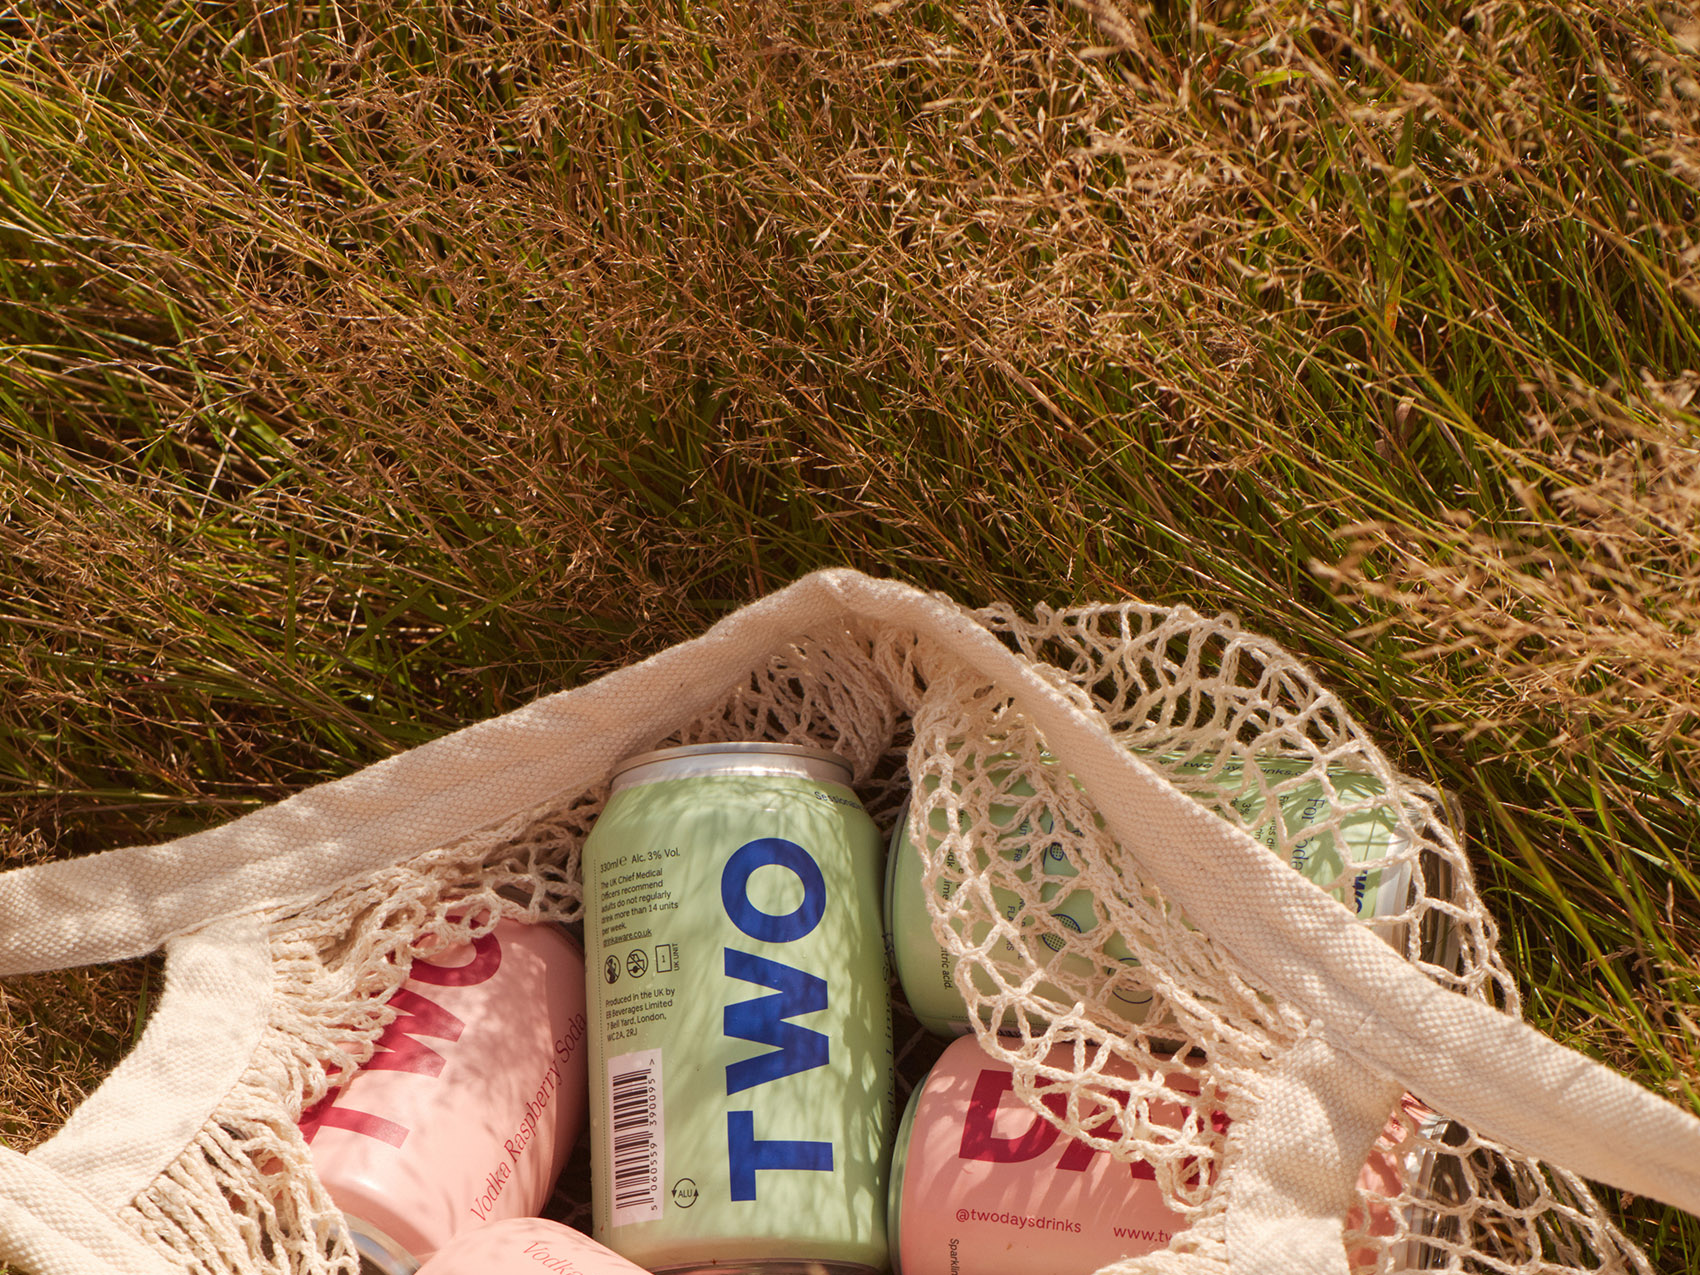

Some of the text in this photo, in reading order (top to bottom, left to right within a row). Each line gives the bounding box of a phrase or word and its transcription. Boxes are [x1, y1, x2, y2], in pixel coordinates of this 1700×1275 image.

[1301, 798, 1326, 824] For
[631, 853, 646, 864] Alc.
[647, 850, 662, 861] 3%
[664, 848, 680, 858] Vol.
[610, 878, 617, 887] UK
[618, 872, 635, 884] Chief
[636, 868, 663, 880] Medical
[621, 880, 664, 895] recommend
[617, 898, 626, 908] do
[626, 896, 638, 905] not
[639, 890, 671, 903] regularly
[614, 910, 630, 920] more
[631, 906, 647, 916] than
[648, 903, 658, 913] 14
[659, 901, 679, 911] units
[672, 943, 680, 960] UNIT
[605, 988, 676, 1008] Produced in the UK by
[612, 1005, 643, 1018] Beverages
[645, 999, 673, 1011] Limited
[637, 1012, 667, 1024] London,
[721, 837, 834, 1202] TWO
[626, 1027, 638, 1038] 2RJ
[648, 1078, 657, 1126] 390095
[470, 1012, 587, 1222] Vodka Raspberry Soda
[650, 1143, 658, 1191] 060559
[678, 1189, 693, 1198] ALU
[955, 1208, 1082, 1234] @twodaysdrinks
